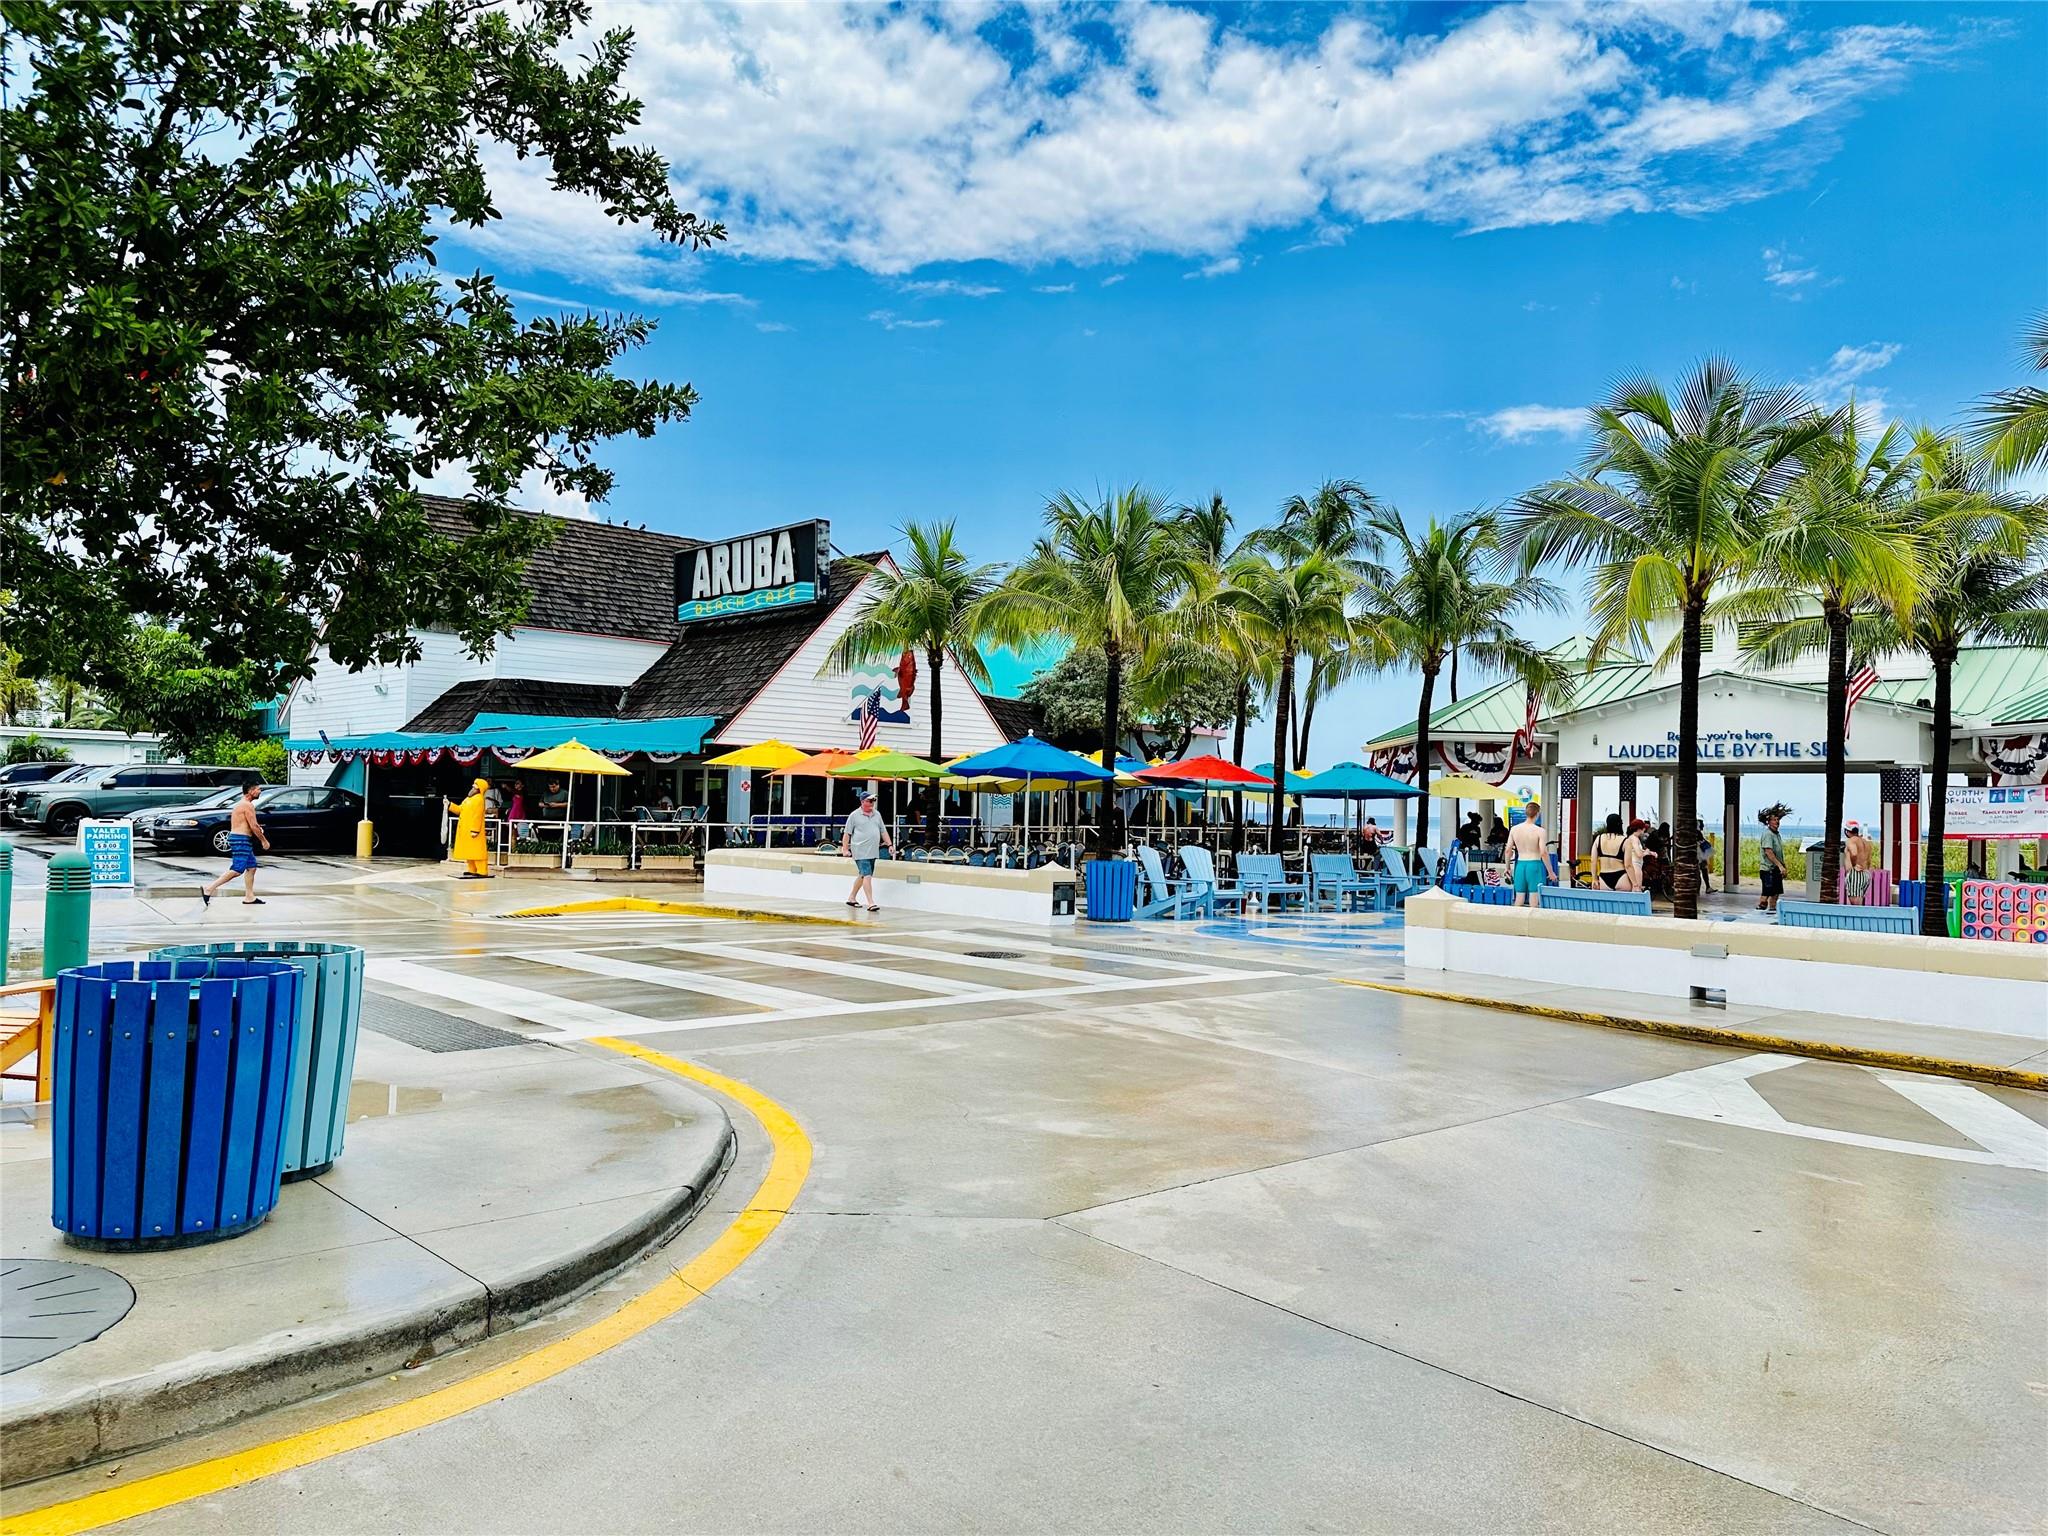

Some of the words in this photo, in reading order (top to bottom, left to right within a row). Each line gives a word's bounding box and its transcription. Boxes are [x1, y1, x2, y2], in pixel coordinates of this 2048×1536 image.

[692, 531, 795, 599] ARUBA
[695, 596, 745, 615] BEACH
[754, 587, 797, 606] CAFE
[1745, 729, 1773, 740] here
[1733, 743, 1757, 758] BY
[1763, 742, 1801, 757] THE
